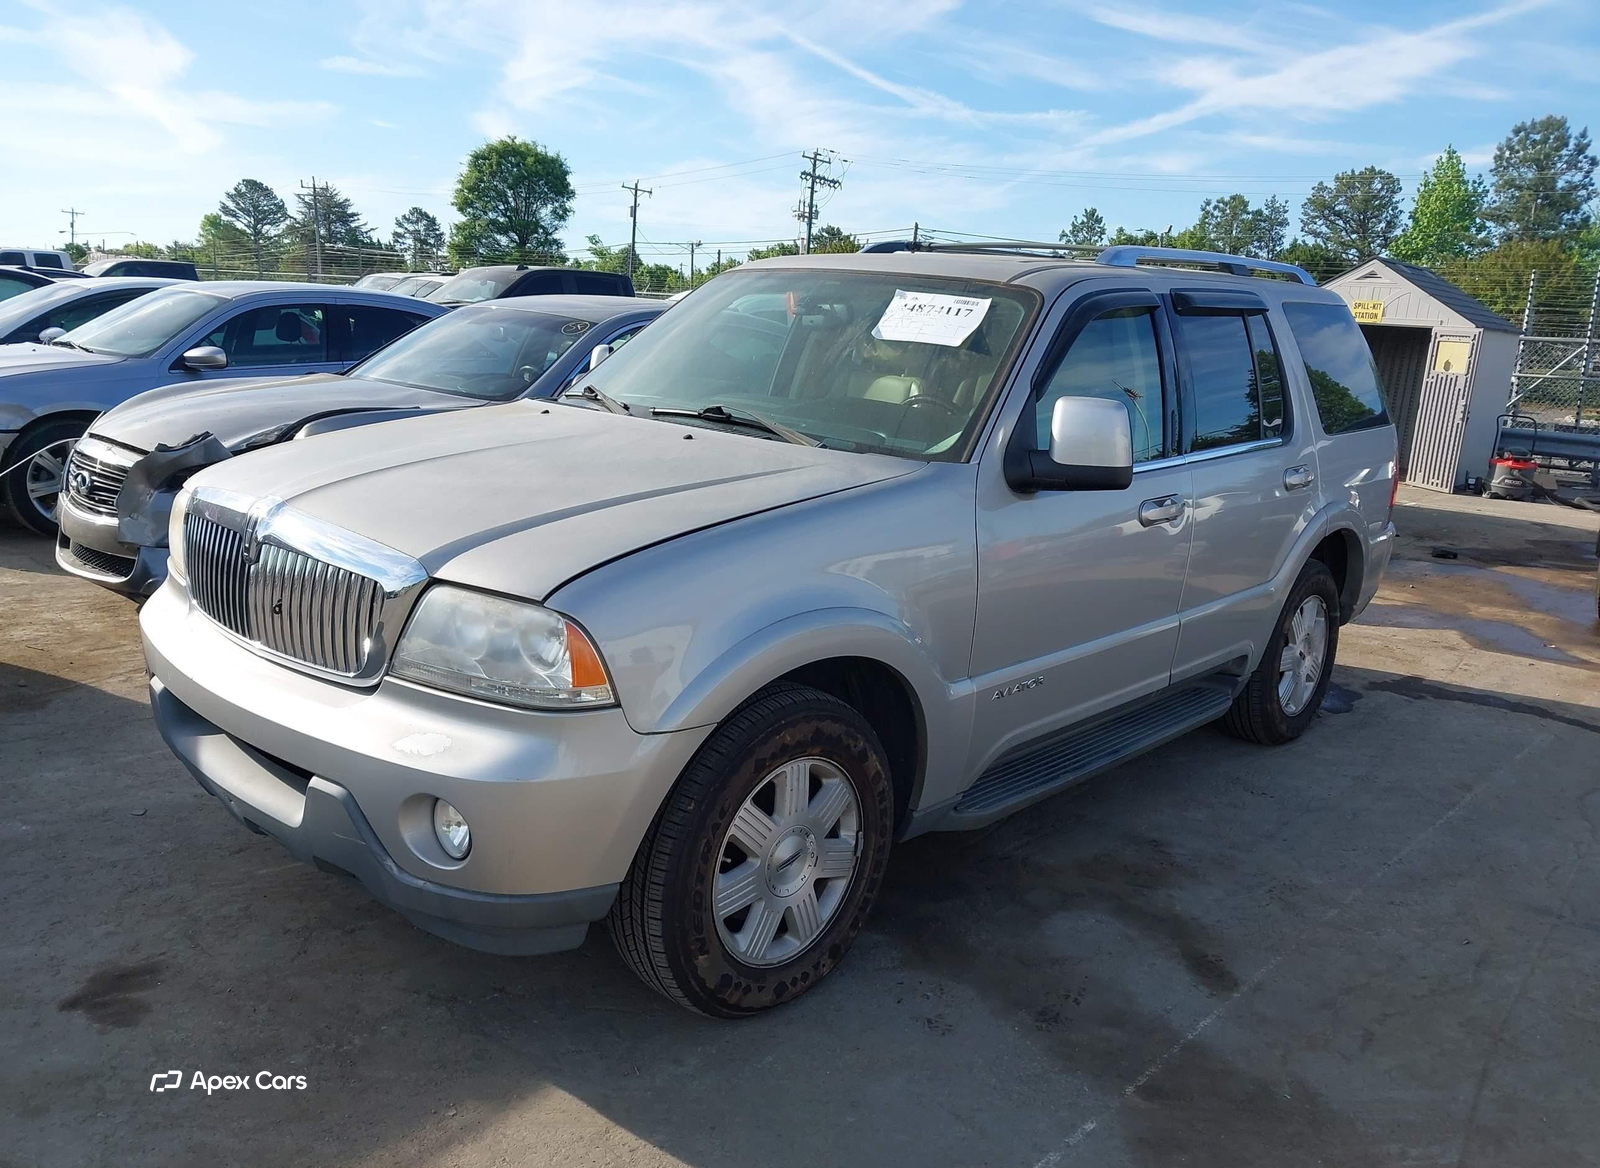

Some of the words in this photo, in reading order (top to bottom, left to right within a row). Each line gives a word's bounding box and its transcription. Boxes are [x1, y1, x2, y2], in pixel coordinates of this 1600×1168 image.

[903, 303, 974, 318] 4874117
[1354, 302, 1382, 310] SPILL-KIT
[1354, 312, 1379, 320] STATION
[991, 675, 1045, 702] AVIATOR
